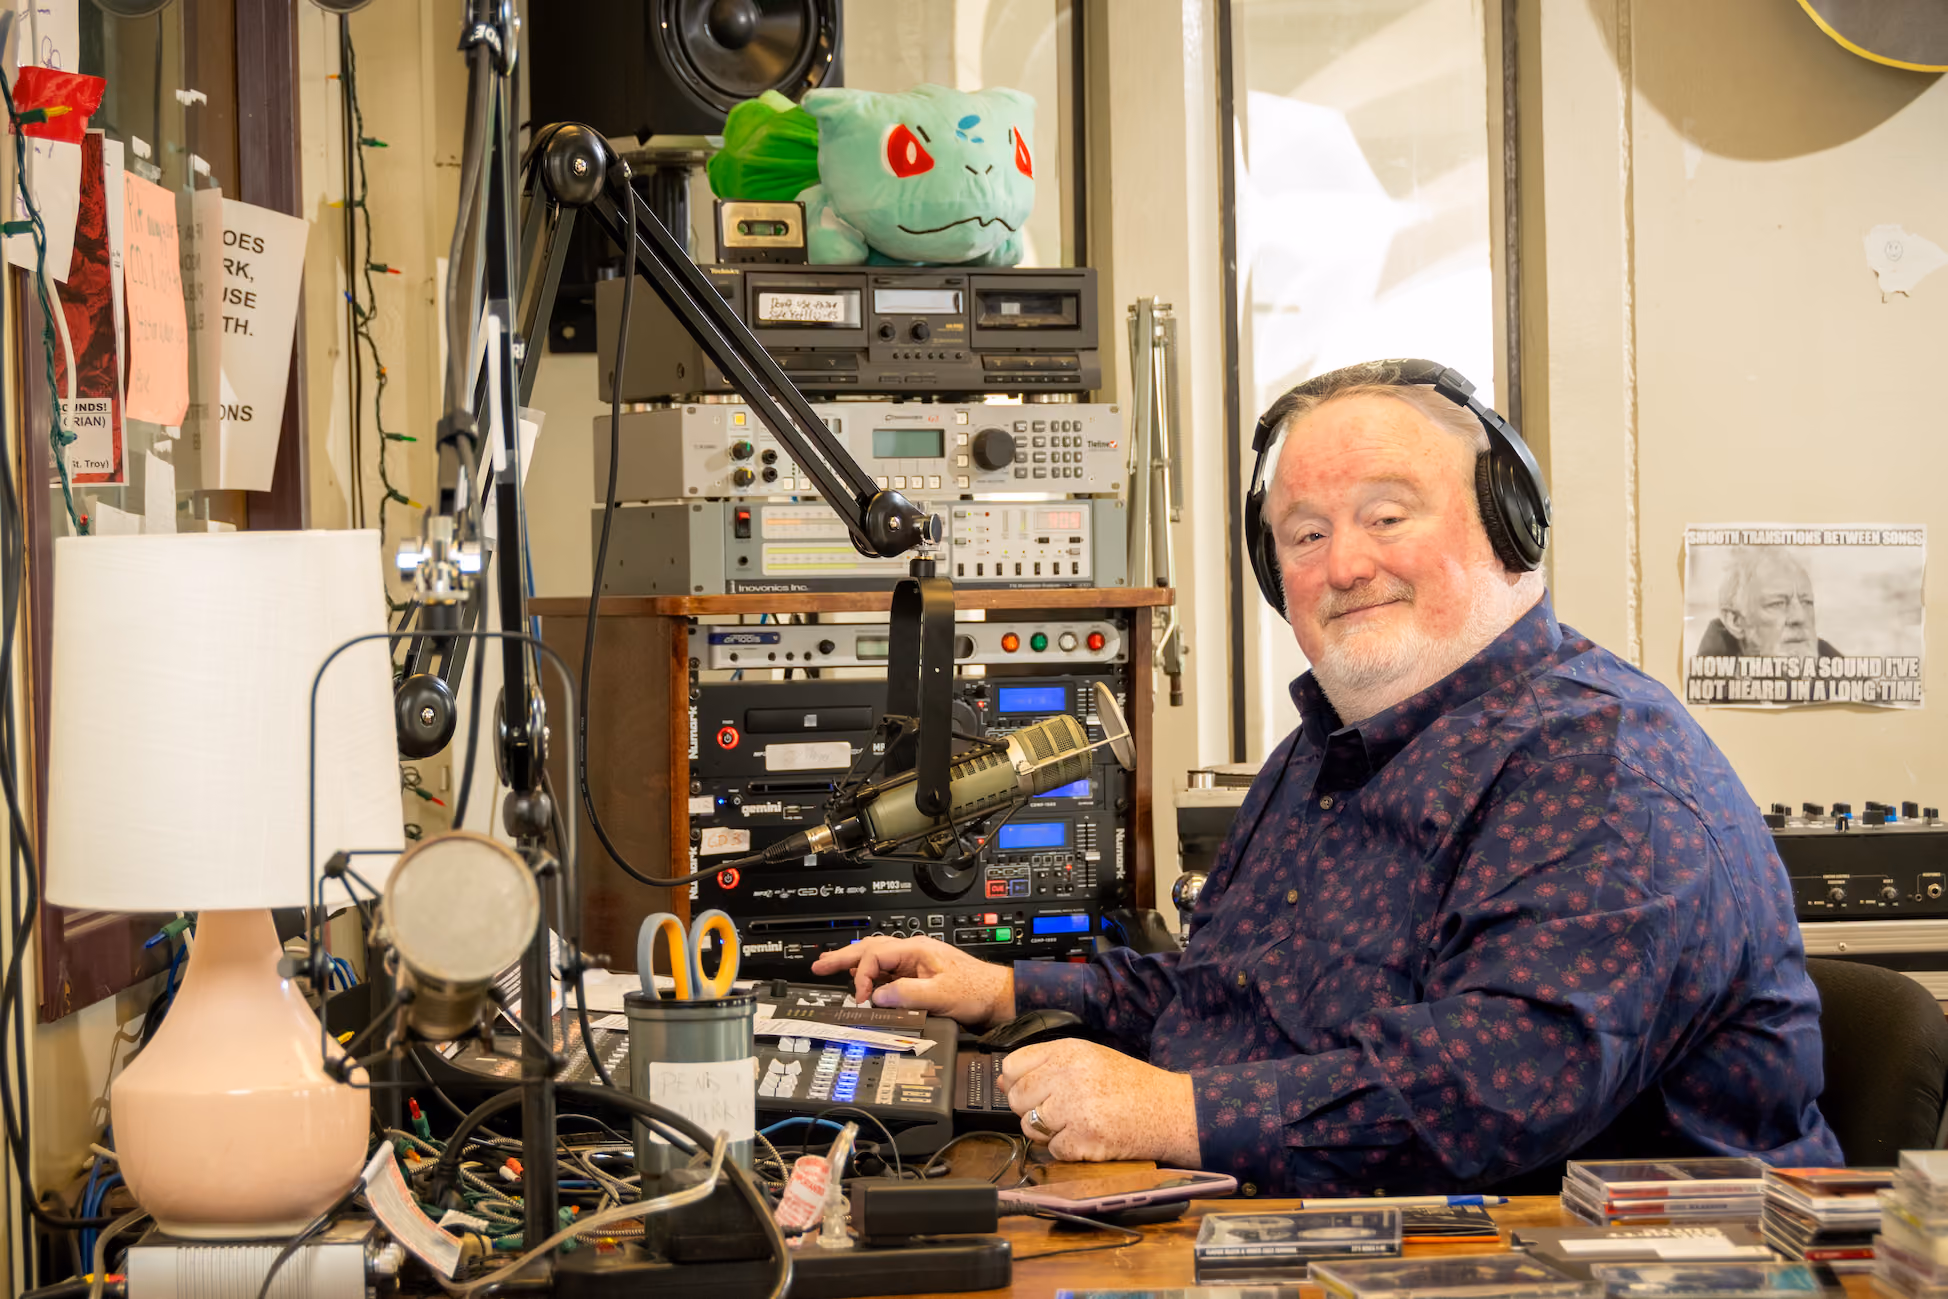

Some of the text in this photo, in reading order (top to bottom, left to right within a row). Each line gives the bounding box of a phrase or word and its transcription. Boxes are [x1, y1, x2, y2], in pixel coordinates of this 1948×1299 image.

[64, 416, 106, 428] (RIAN)
[85, 459, 109, 469] Troy)
[1688, 529, 1923, 546] SMOOTH TRANSITIONS BETWEEN SONGS
[1690, 655, 1920, 678] NOW THAT'S A SOUND I'VE
[1688, 679, 1922, 701] NOT HEARD IN A LONG TIME
[688, 705, 699, 760] Numark
[741, 801, 782, 817] gemini
[1115, 827, 1126, 880] Numark
[872, 881, 900, 890] MP103
[742, 941, 783, 957] gemini
